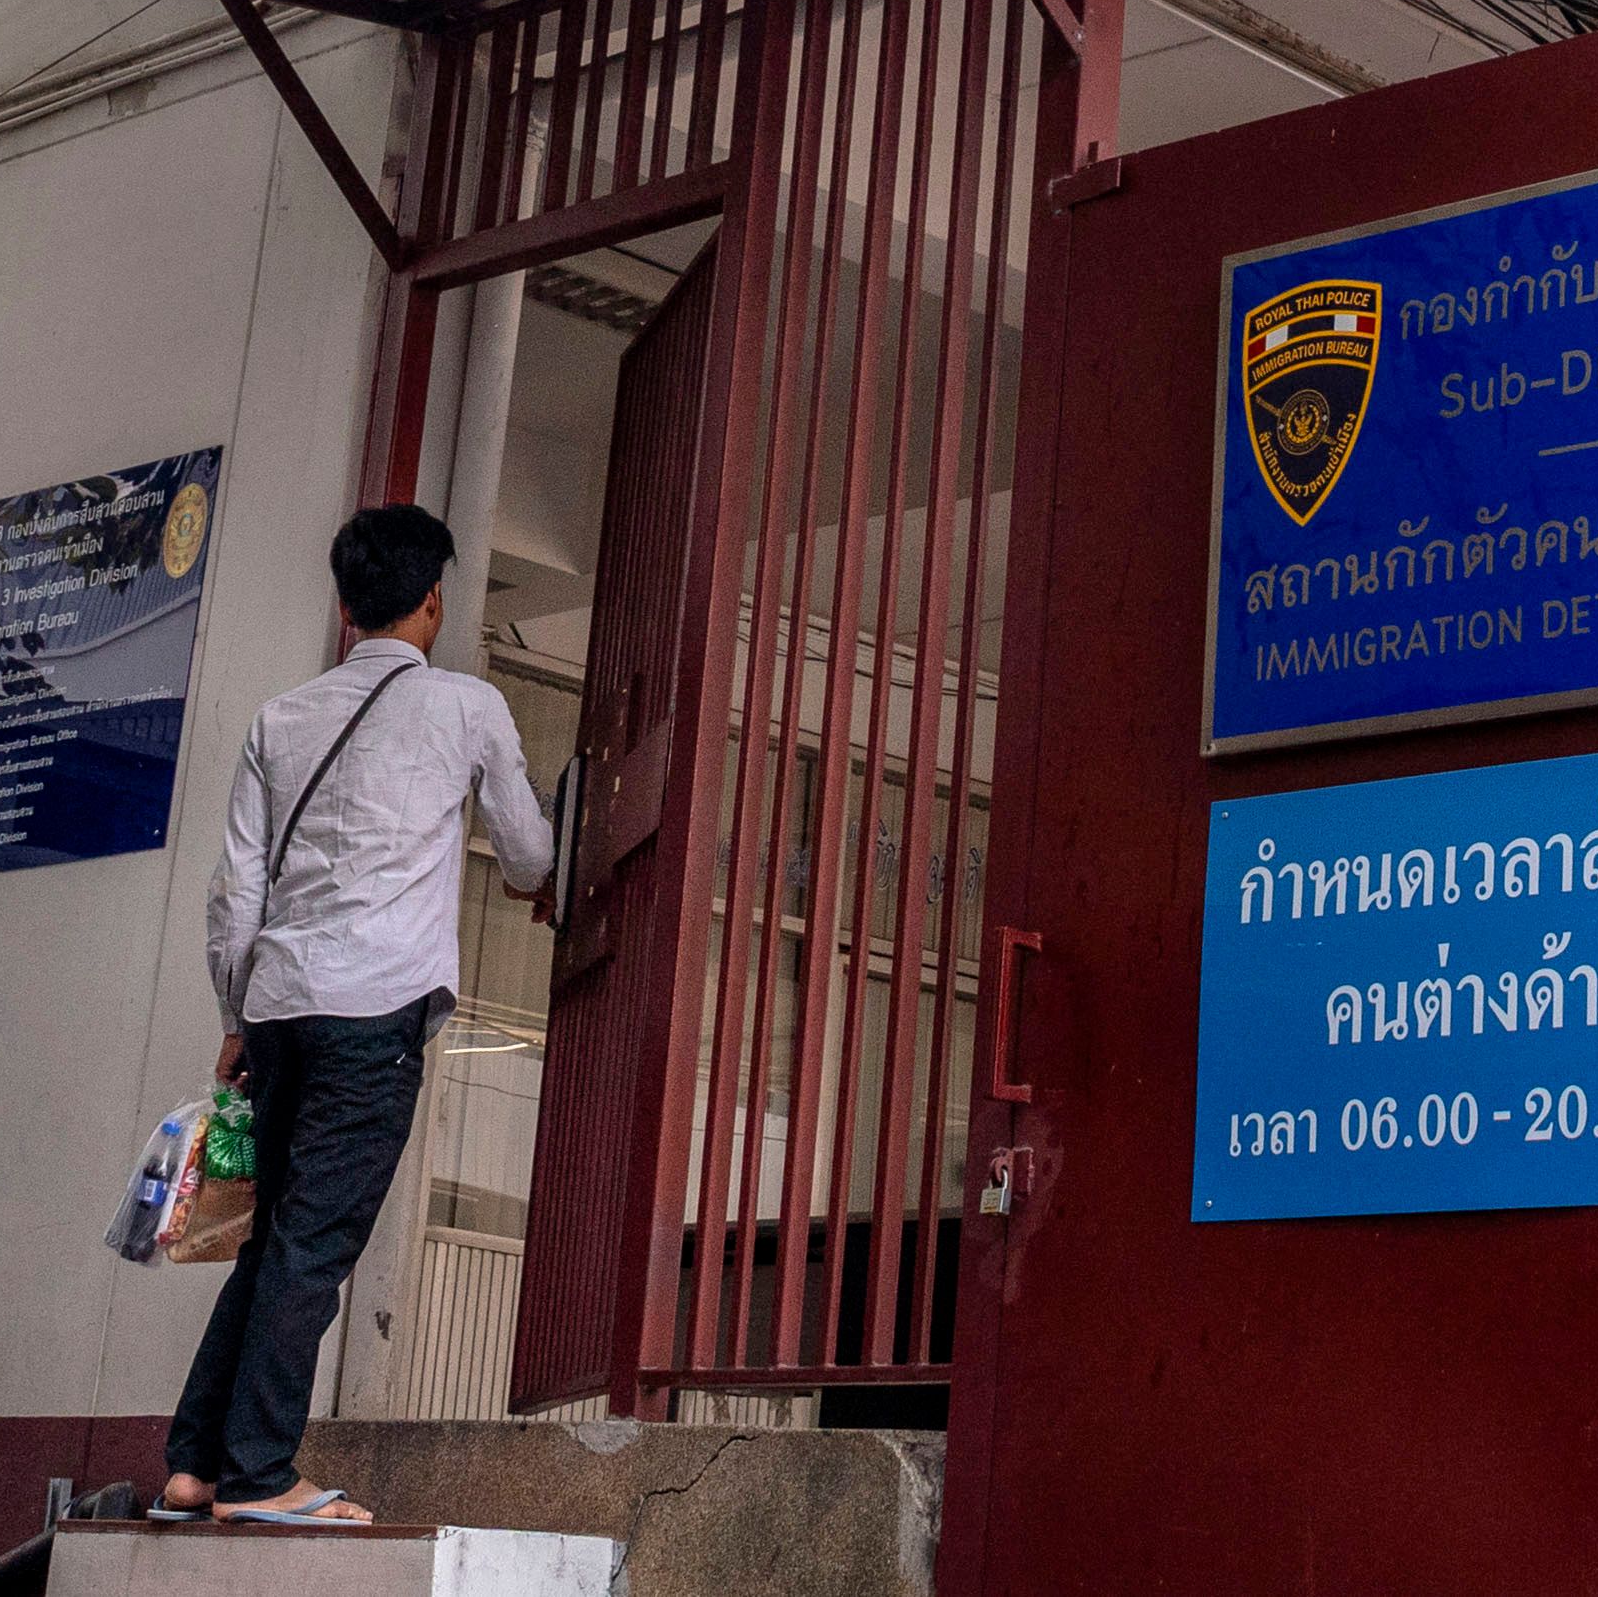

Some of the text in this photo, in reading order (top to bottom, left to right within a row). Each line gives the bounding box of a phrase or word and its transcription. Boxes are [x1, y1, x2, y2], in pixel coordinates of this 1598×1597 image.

[1255, 291, 1371, 331] ROYAL THAI POLICE
[1251, 340, 1369, 381] IMMIGRATION BUREAU
[2, 589, 10, 606] 3
[13, 574, 85, 604] Investigation
[89, 562, 138, 589] Division
[37, 610, 79, 635] Bureau
[1256, 605, 1523, 681] IMMIGRATION
[1228, 1111, 1319, 1156] เวลา
[1341, 1092, 1479, 1151] 06.00
